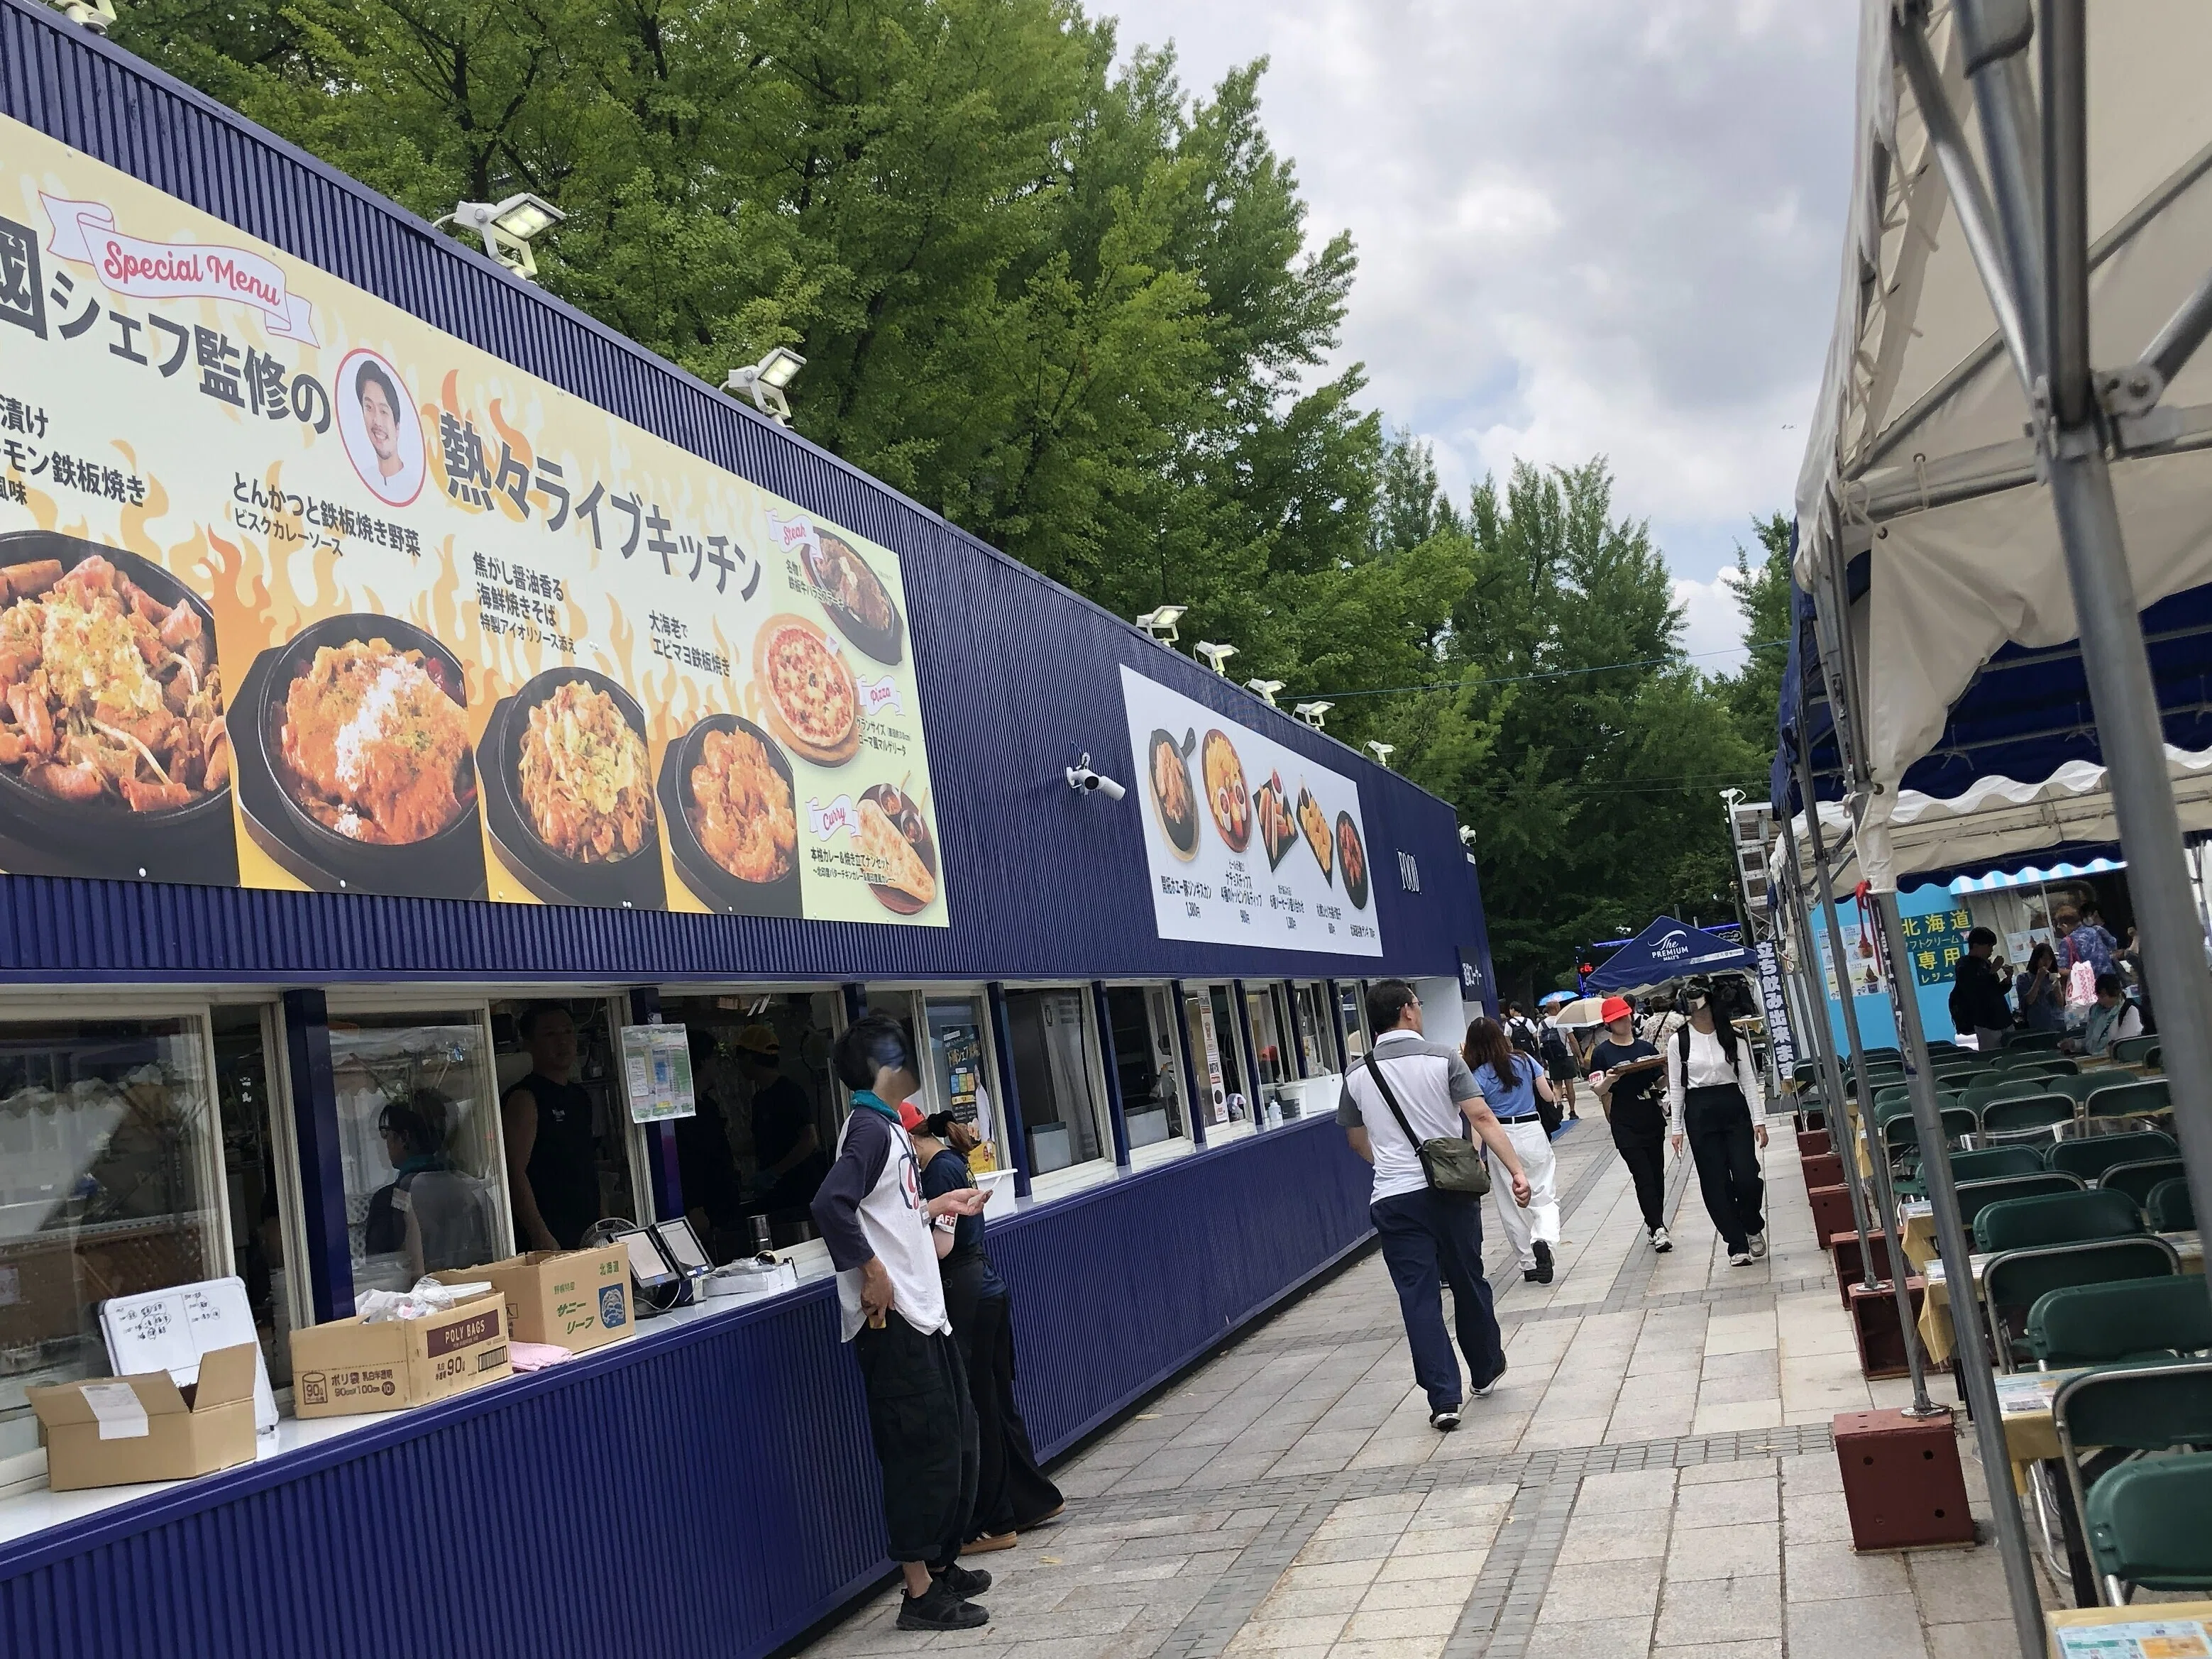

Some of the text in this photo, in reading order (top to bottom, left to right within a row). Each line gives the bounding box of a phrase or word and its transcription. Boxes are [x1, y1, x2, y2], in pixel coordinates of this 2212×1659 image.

[104, 241, 281, 306] Special Menu
[0, 439, 145, 507] モン鉄板焼き
[233, 472, 422, 558] とんかつと鉄板焼き野菜
[441, 412, 761, 602] 熱々ライブキッチン
[235, 508, 343, 557] ビスクカレーソース
[783, 523, 806, 545] Steak
[473, 551, 563, 601] 焦がし醤油香る
[477, 581, 556, 627] 海鮮焼きそば
[480, 612, 576, 654] 特製アイオリソース添え
[649, 610, 688, 639] 大海老で
[653, 637, 730, 677] エビマヨ鉄板焼き
[871, 688, 891, 705] Pizza
[823, 807, 846, 830] Curry
[1902, 909, 1971, 937] 北海道
[1652, 946, 1688, 958] PREMIUM
[1906, 935, 1959, 952] フトクリーム
[1917, 947, 1961, 970] 専用
[1756, 942, 1793, 1076] 立ち飲み出来ます
[937, 1213, 955, 1225] AFF
[556, 1301, 586, 1317] サニー
[445, 1325, 463, 1344] POLY
[467, 1319, 485, 1338] BAGS
[567, 1316, 595, 1335] リーフ
[331, 1372, 360, 1386] ポリ袋
